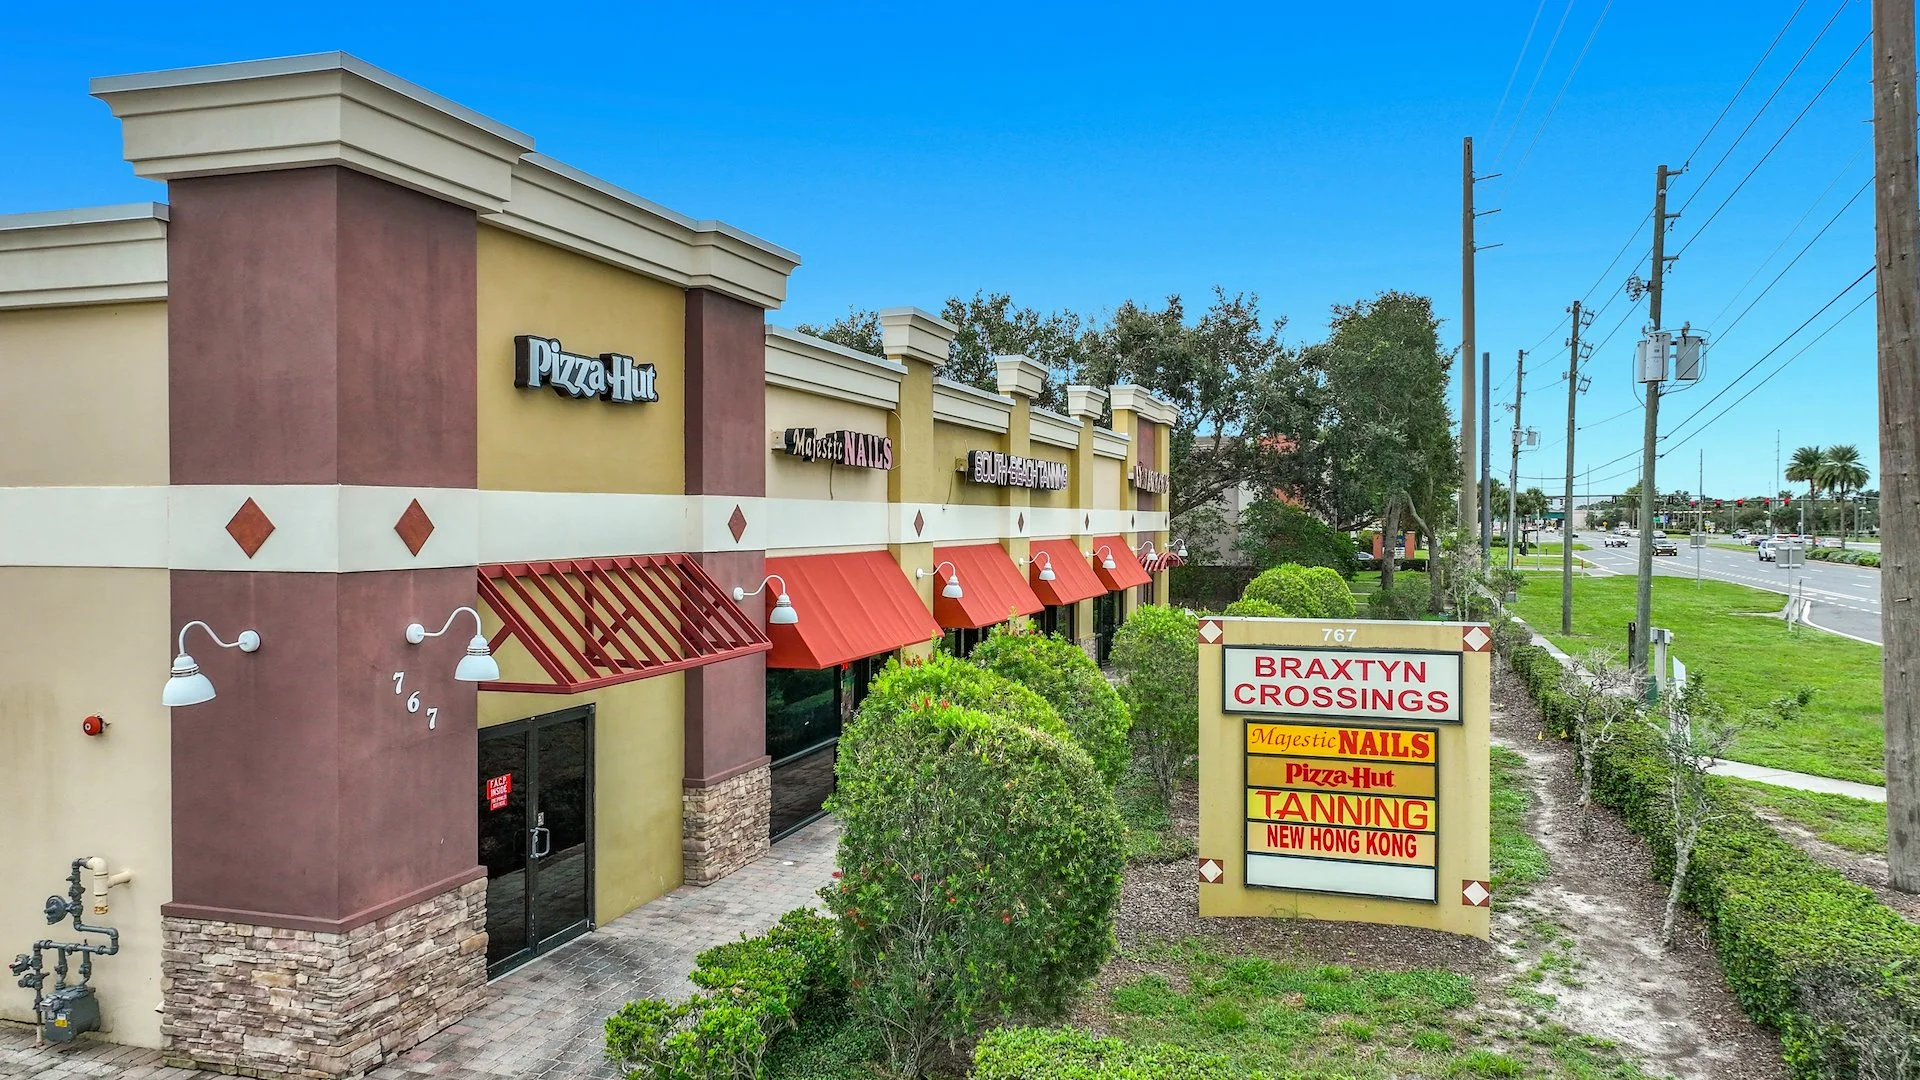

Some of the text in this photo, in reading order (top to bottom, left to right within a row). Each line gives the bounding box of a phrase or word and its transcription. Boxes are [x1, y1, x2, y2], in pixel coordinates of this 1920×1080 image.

[527, 337, 658, 402] Pizza Hut
[792, 427, 893, 471] Majestic NAILS
[974, 450, 1008, 486] SOUTH
[1008, 455, 1038, 489] BEACH
[1321, 628, 1357, 643] 767
[1255, 656, 1426, 683] BRAXTYN
[392, 671, 439, 730] 767
[1233, 683, 1449, 713] CROSSINGS
[1251, 727, 1430, 759] Majestic NAILS
[1285, 763, 1395, 789] Pizza Hut
[1255, 790, 1428, 830] TANNING
[1267, 824, 1417, 859] NEW HONG KONG
